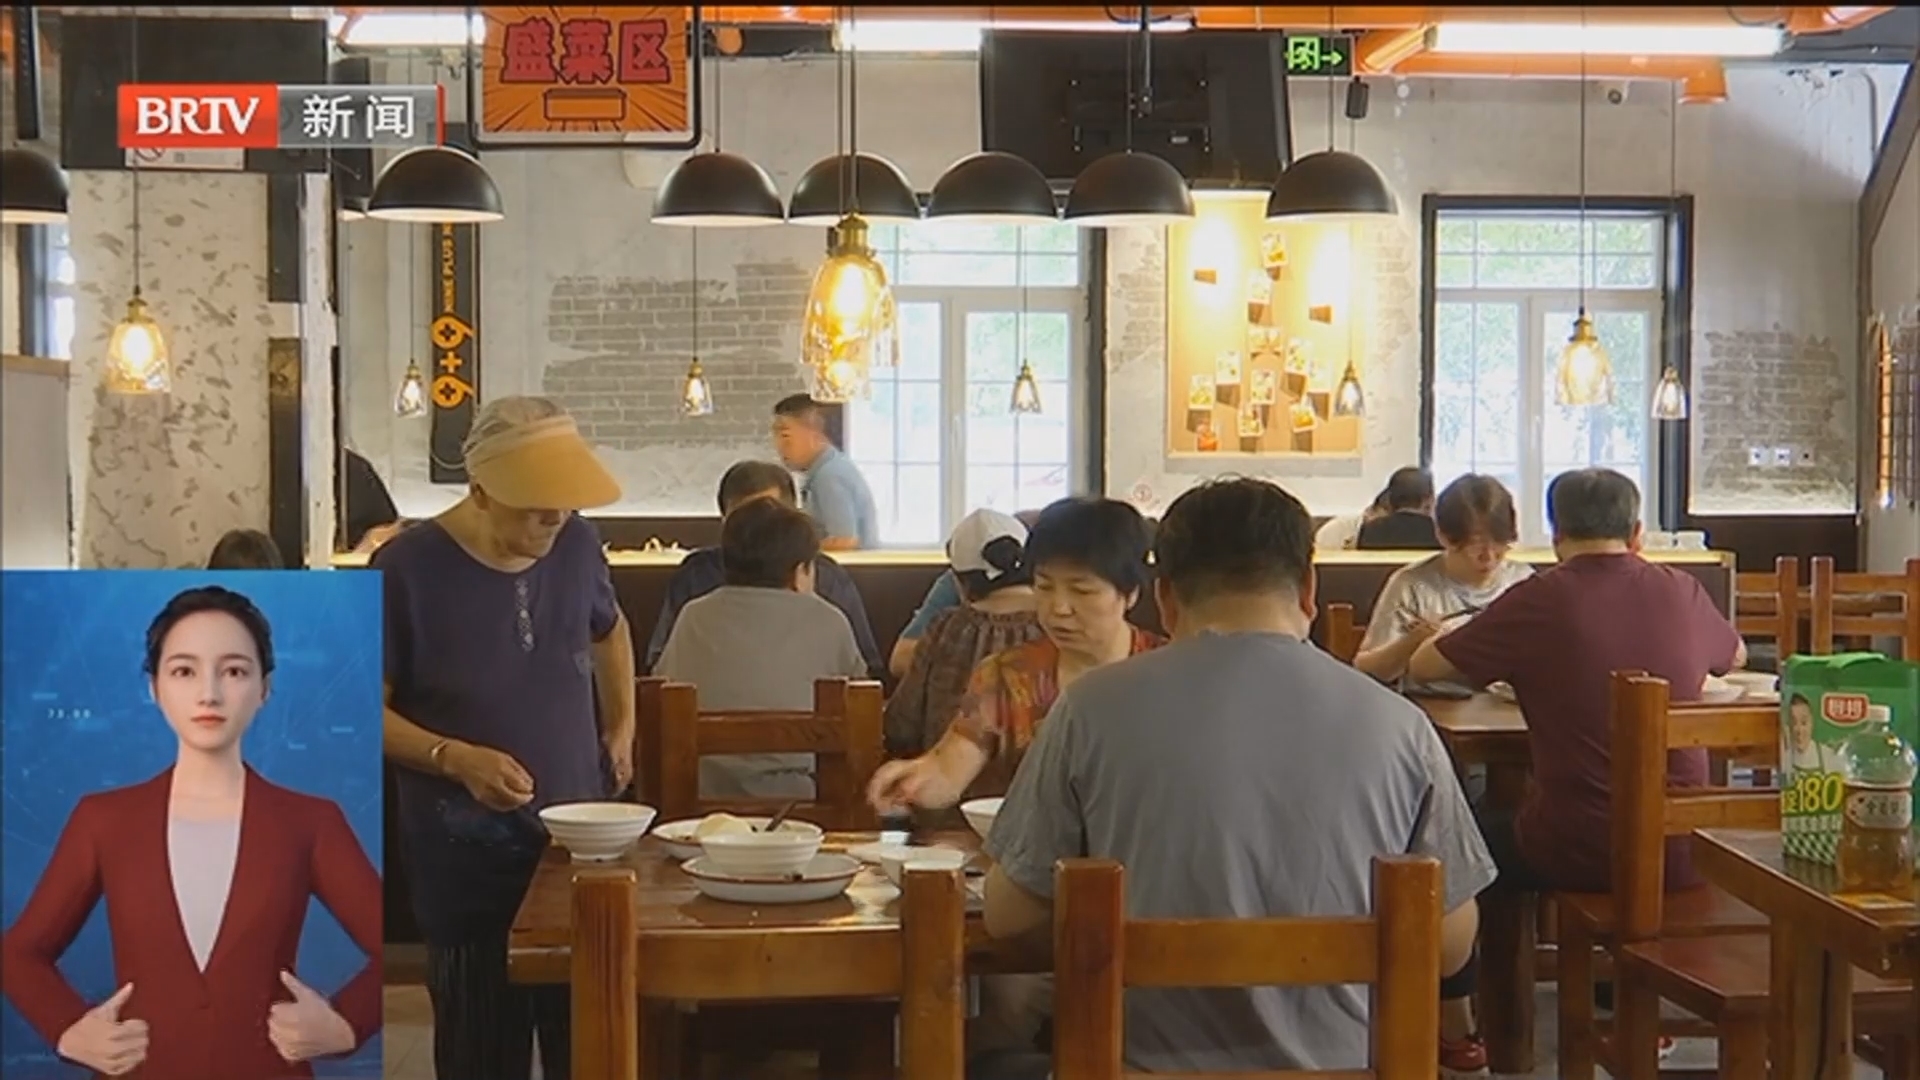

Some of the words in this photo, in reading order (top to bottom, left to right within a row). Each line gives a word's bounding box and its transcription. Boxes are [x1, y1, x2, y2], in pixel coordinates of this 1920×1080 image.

[501, 16, 671, 84] 盛菜区
[441, 239, 455, 277] PLUS
